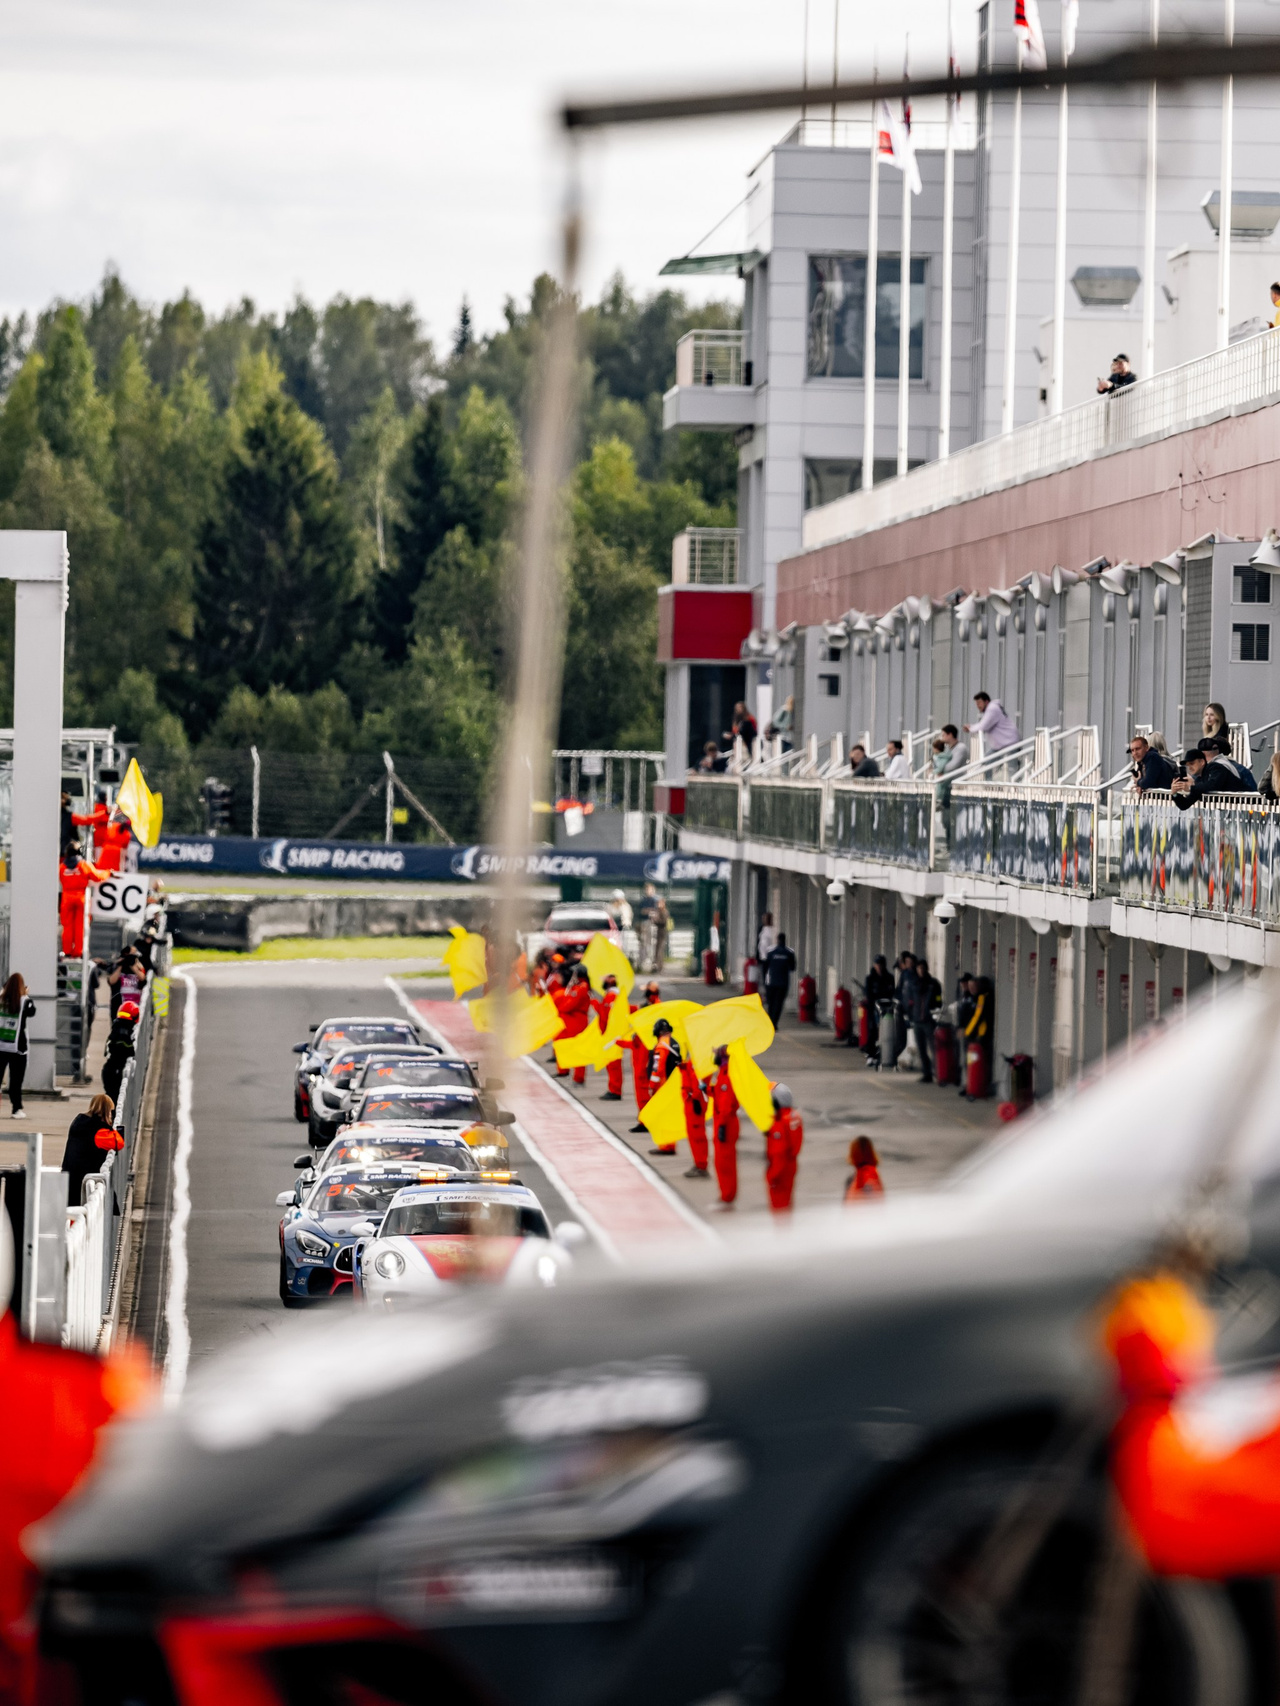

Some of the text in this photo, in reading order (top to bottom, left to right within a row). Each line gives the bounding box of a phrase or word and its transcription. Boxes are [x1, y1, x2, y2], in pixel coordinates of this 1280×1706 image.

[287, 848, 405, 872] SMP RACING
[526, 855, 599, 876] RACING
[97, 882, 143, 914] SC
[366, 1101, 393, 1113] 77
[326, 1183, 356, 1198] 51
